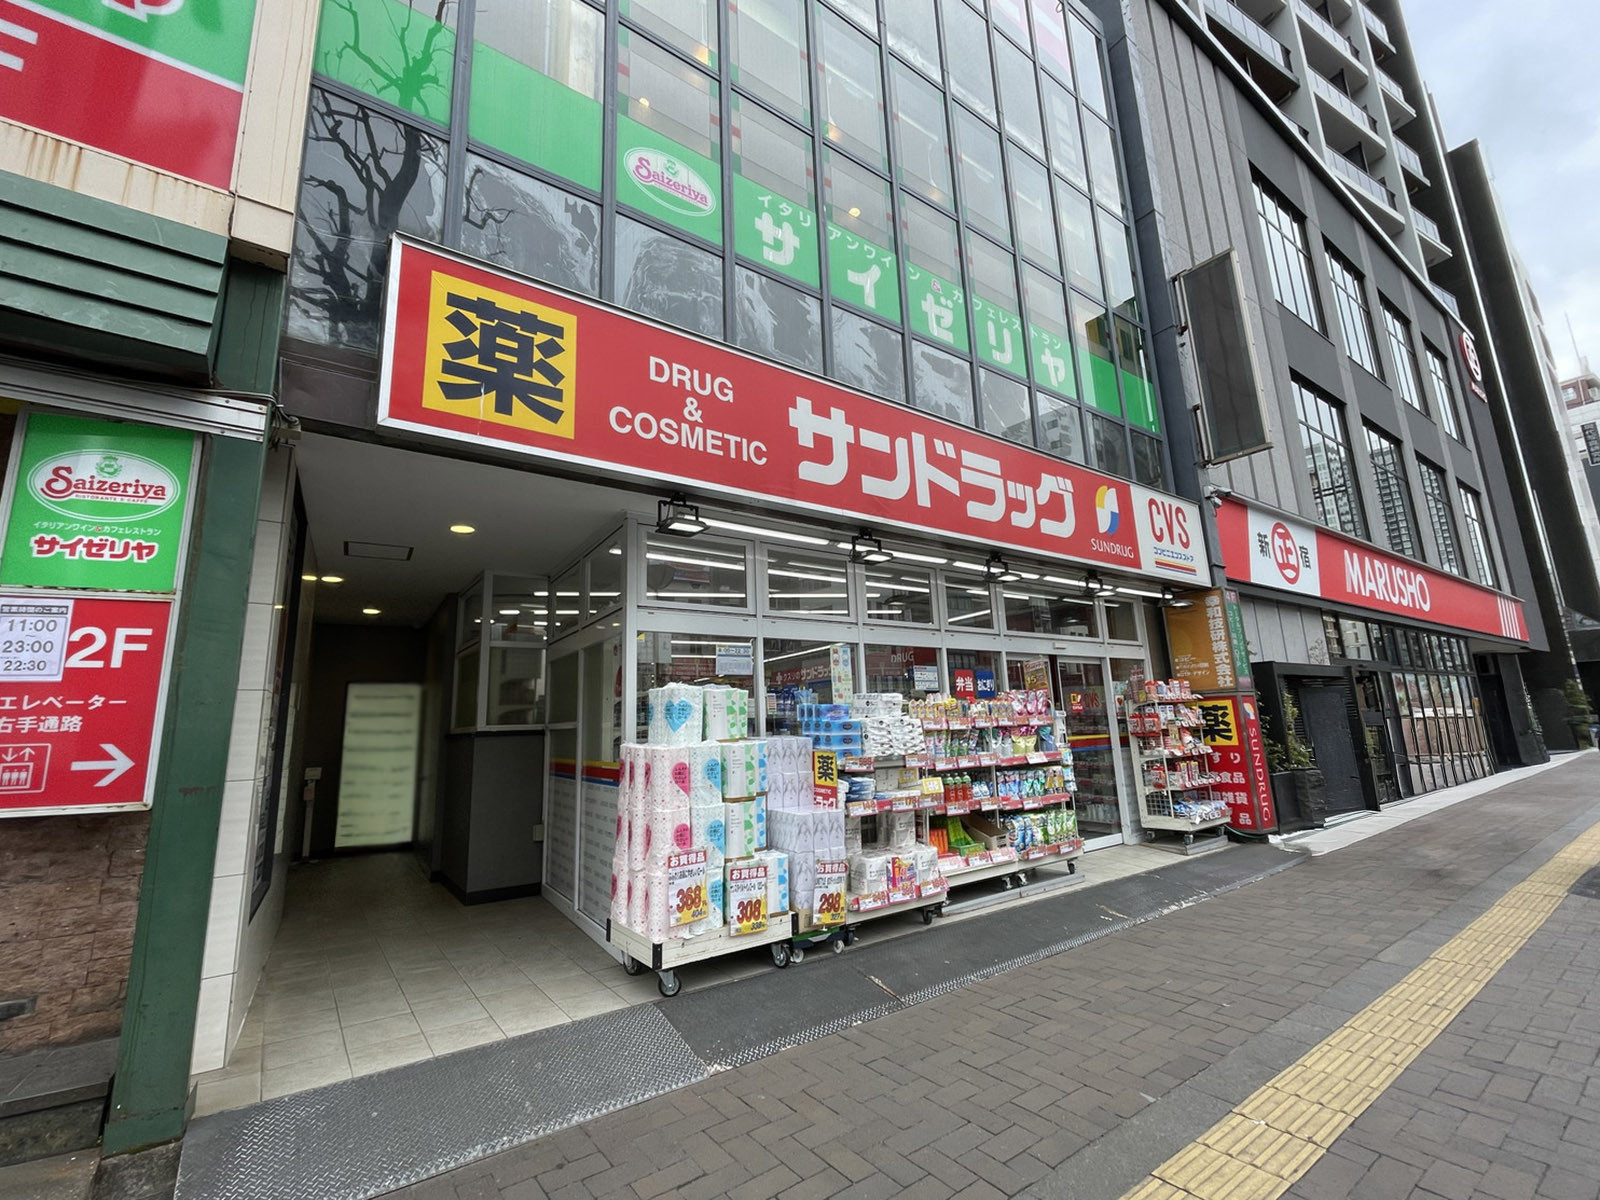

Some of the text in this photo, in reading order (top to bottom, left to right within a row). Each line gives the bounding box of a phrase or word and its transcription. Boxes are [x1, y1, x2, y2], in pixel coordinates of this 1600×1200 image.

[632, 156, 709, 207] Saizeriya
[437, 291, 566, 425] 薬
[649, 356, 734, 403] DRUG
[683, 397, 704, 423] &
[608, 406, 768, 466] COSMETIC
[788, 396, 1077, 539] サンドラッグ
[40, 465, 167, 501] Saizeriya
[1148, 497, 1191, 550] CVS
[32, 534, 157, 562] サイゼリヤ
[1090, 538, 1135, 559] SUNDRUG
[1343, 548, 1432, 613] MARUSHO
[7, 618, 58, 633] 11:00
[2, 639, 54, 654] 23:00
[64, 626, 154, 669] 2F
[3, 659, 47, 672] 22:30
[955, 677, 974, 692] 弁当
[0, 694, 127, 711] エレベーター
[0, 715, 83, 734] 右手通路
[1199, 704, 1234, 742] 薬
[817, 754, 836, 782] 薬
[1248, 727, 1271, 821] SUNDRUG
[669, 850, 705, 868] お買得品
[731, 867, 766, 880] お買得品
[736, 898, 762, 925] 308
[818, 892, 842, 915] 298
